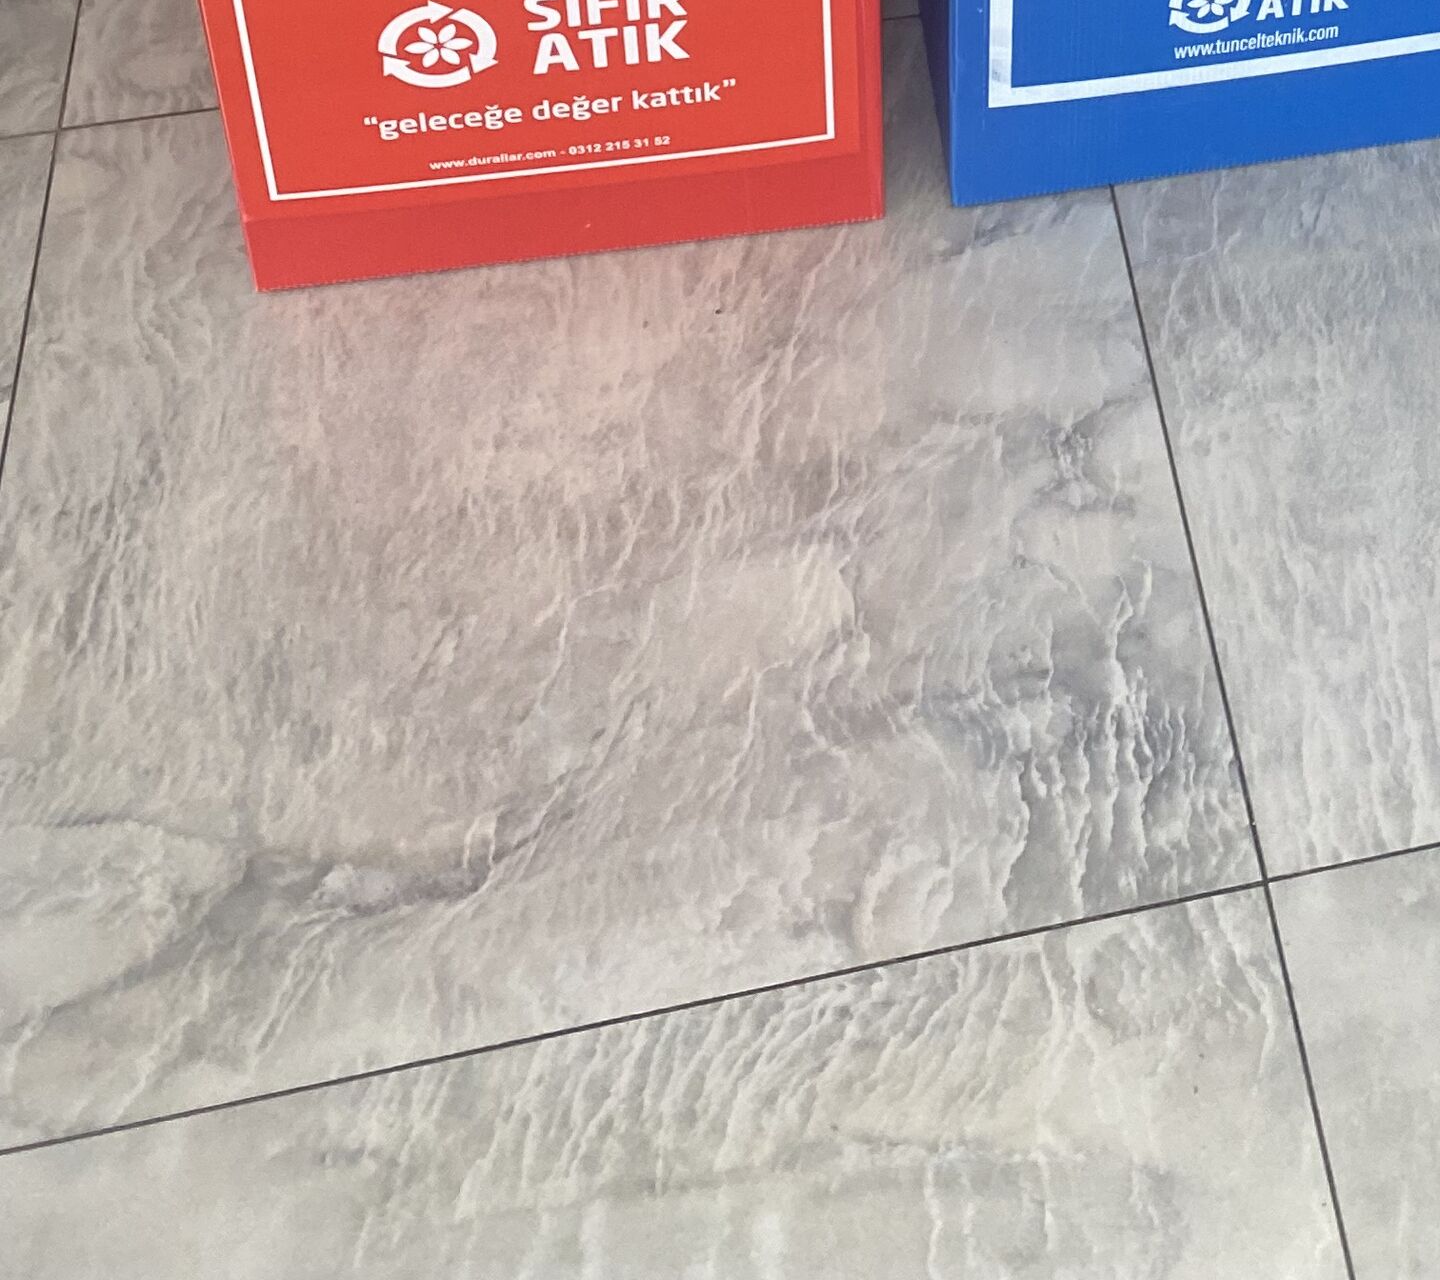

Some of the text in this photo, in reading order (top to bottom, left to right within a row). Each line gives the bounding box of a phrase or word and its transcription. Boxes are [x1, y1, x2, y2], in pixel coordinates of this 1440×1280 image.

[533, 19, 690, 75] ATIK
[1174, 26, 1340, 60] www.tuncelteknik.com
[532, 95, 623, 121] değer
[429, 149, 557, 171] www.durallar.com
[568, 143, 603, 156] 0312
[605, 139, 632, 152] 215
[634, 138, 650, 150] 31
